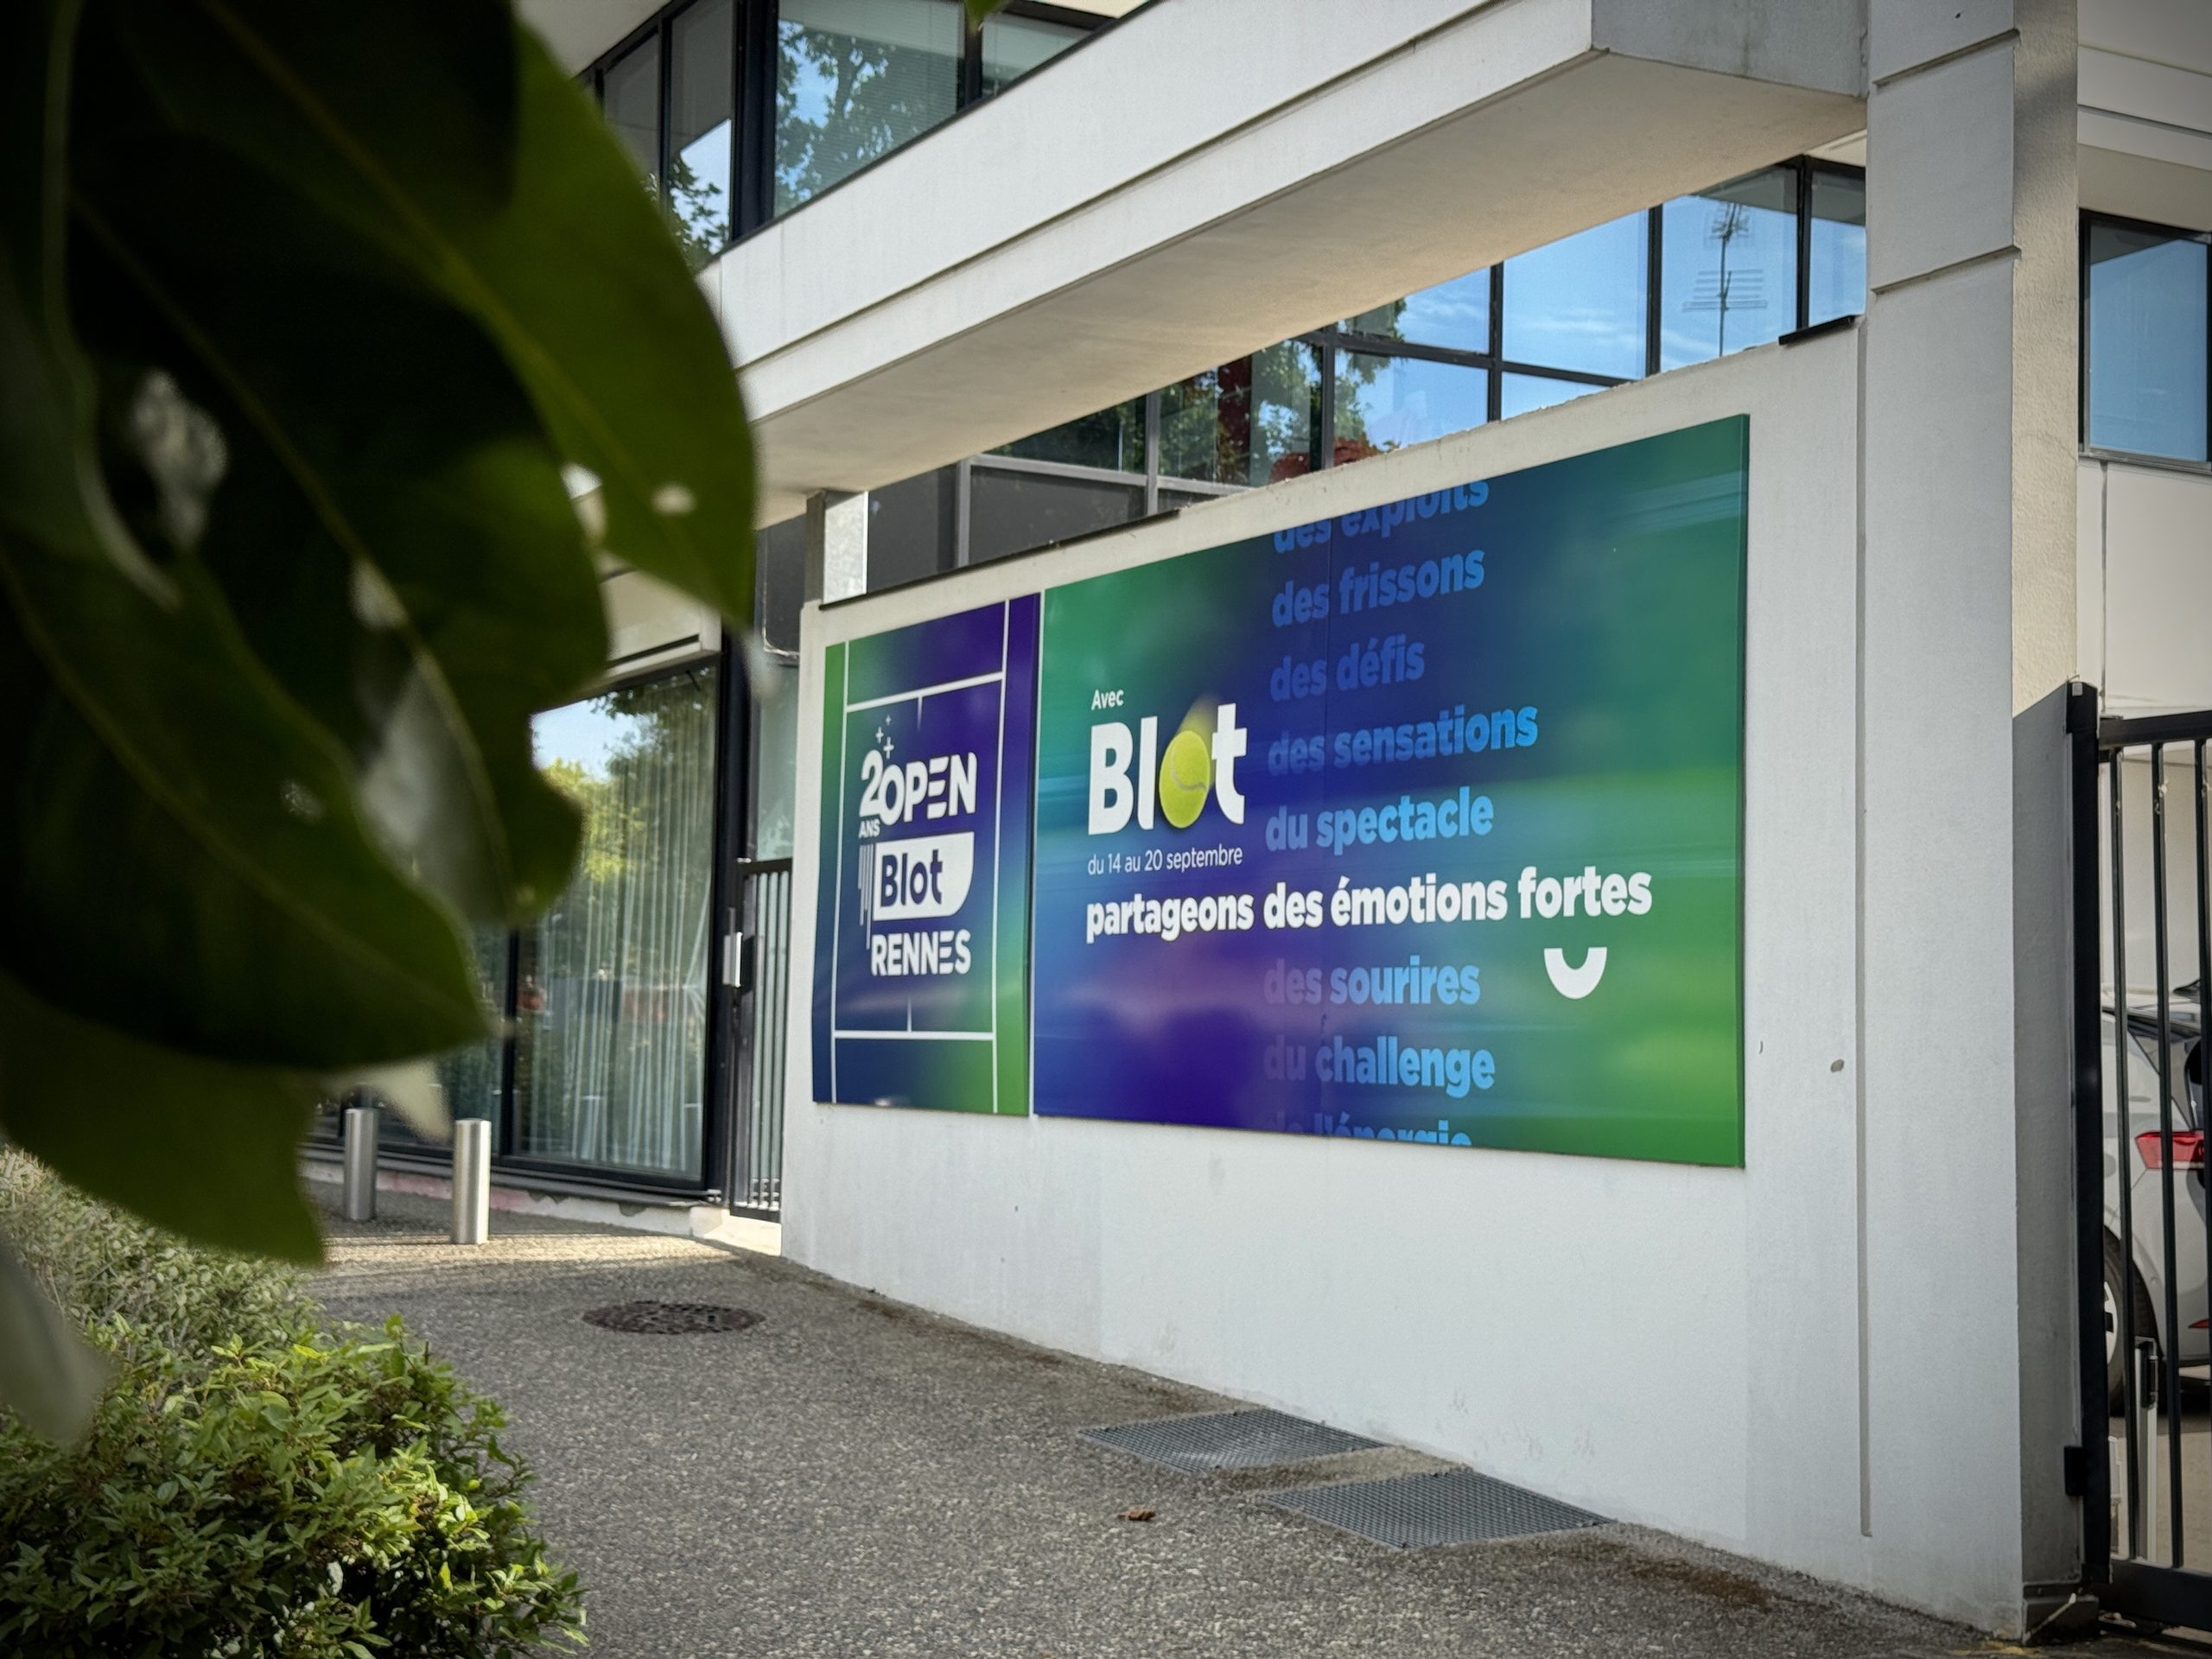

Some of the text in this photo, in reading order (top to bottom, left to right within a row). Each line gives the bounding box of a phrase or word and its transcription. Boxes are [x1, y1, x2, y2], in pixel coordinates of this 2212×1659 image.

[1272, 550, 1484, 628] des frissons
[1270, 634, 1425, 702] des défis
[1091, 689, 1124, 710] Avec
[1088, 702, 1248, 836] Blot
[1268, 705, 1538, 775] des sensations
[858, 818, 880, 839] ANS
[1265, 786, 1494, 855] du spectacle
[880, 849, 943, 907] Blot
[1088, 843, 1243, 874] du 14 au 20 septembre
[1086, 866, 1652, 944] partageons des émotions fortes
[871, 930, 971, 976] RENNES
[1263, 955, 1479, 1005] des sourires
[1264, 1036, 1495, 1098] du challenge
